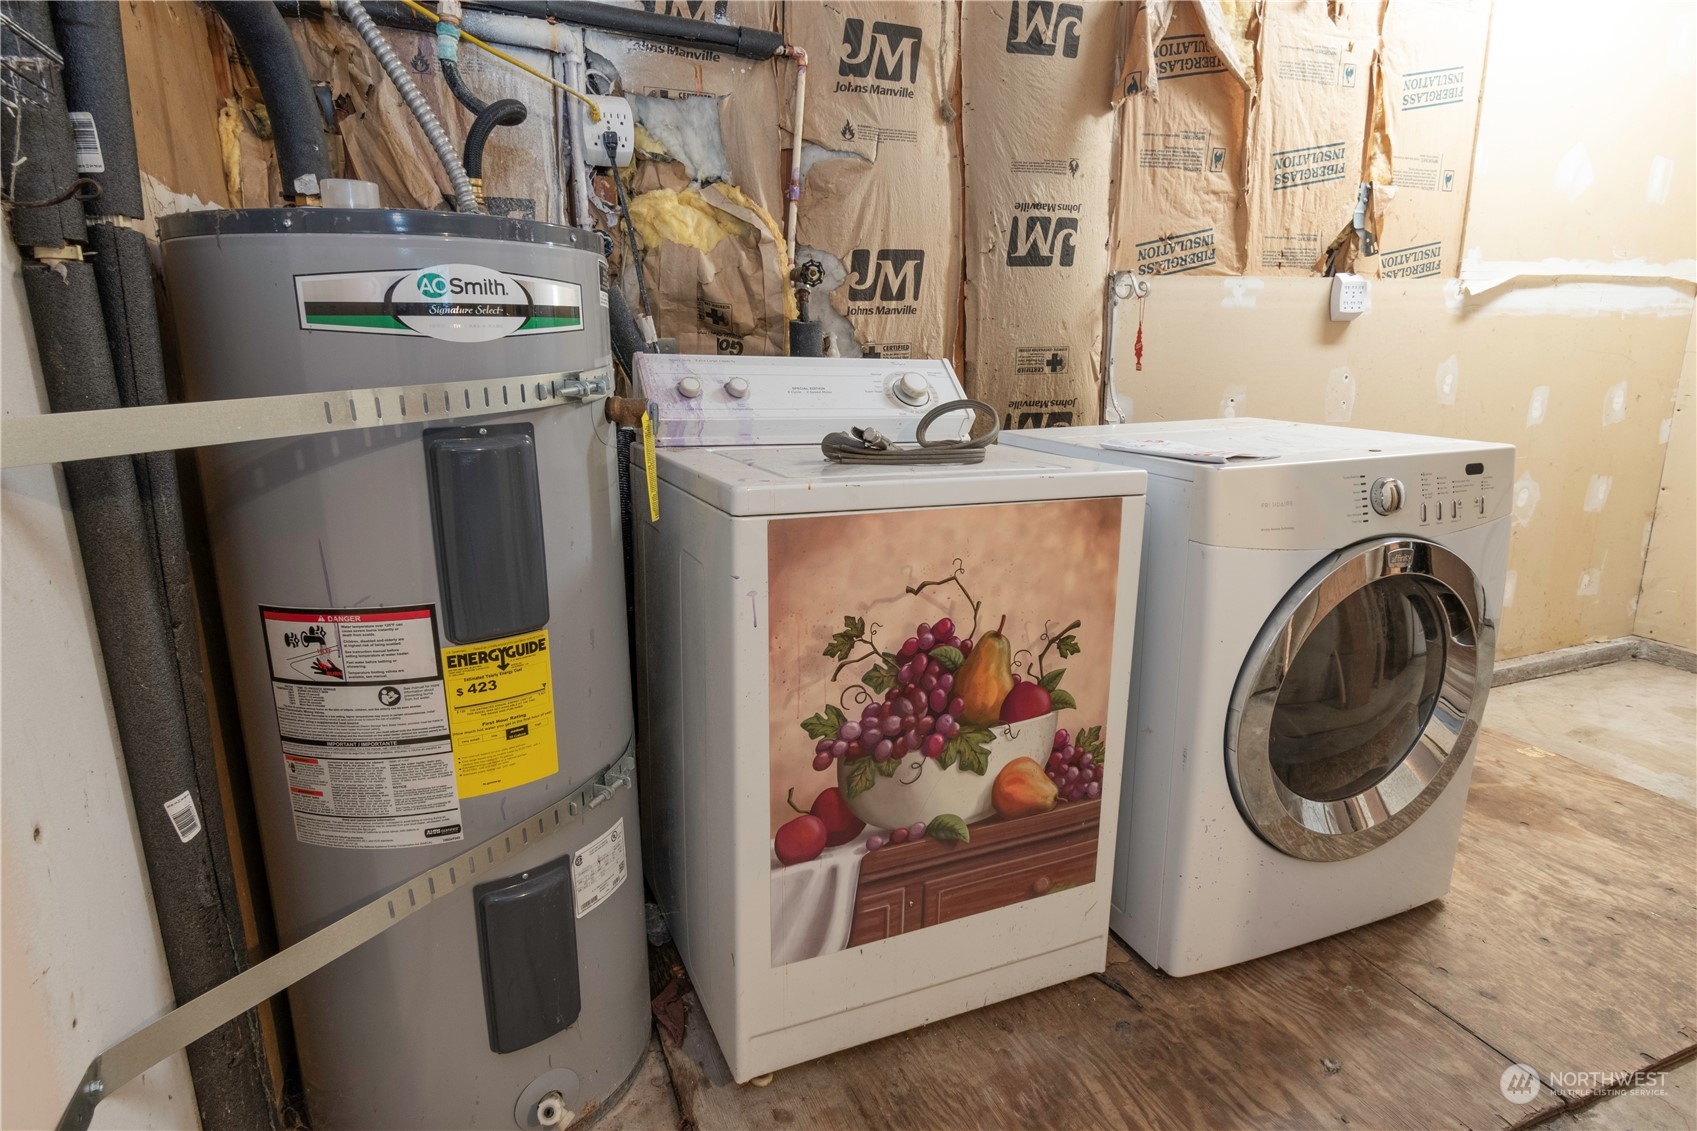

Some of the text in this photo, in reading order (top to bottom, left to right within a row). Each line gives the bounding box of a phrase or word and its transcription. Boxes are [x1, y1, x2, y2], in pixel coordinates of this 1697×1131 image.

[667, 45, 720, 62] Manville
[839, 18, 922, 84] JM
[833, 82, 914, 98] Johns Manville
[1403, 72, 1464, 91] INSULATION
[1402, 86, 1464, 106] FIBERGLASS
[1274, 148, 1345, 170] INSULATION
[1275, 163, 1345, 184] FIBERGLASS
[1014, 202, 1082, 214] Johns Manville
[1006, 216, 1078, 266] JM
[1138, 234, 1214, 262] INSULATION
[848, 249, 925, 301] JM
[429, 304, 473, 315] Signature
[847, 305, 917, 316] Johns Manville
[1008, 398, 1078, 410] Johns Manville
[447, 638, 546, 670] ENERGYGUIDE
[468, 680, 497, 694] 423
